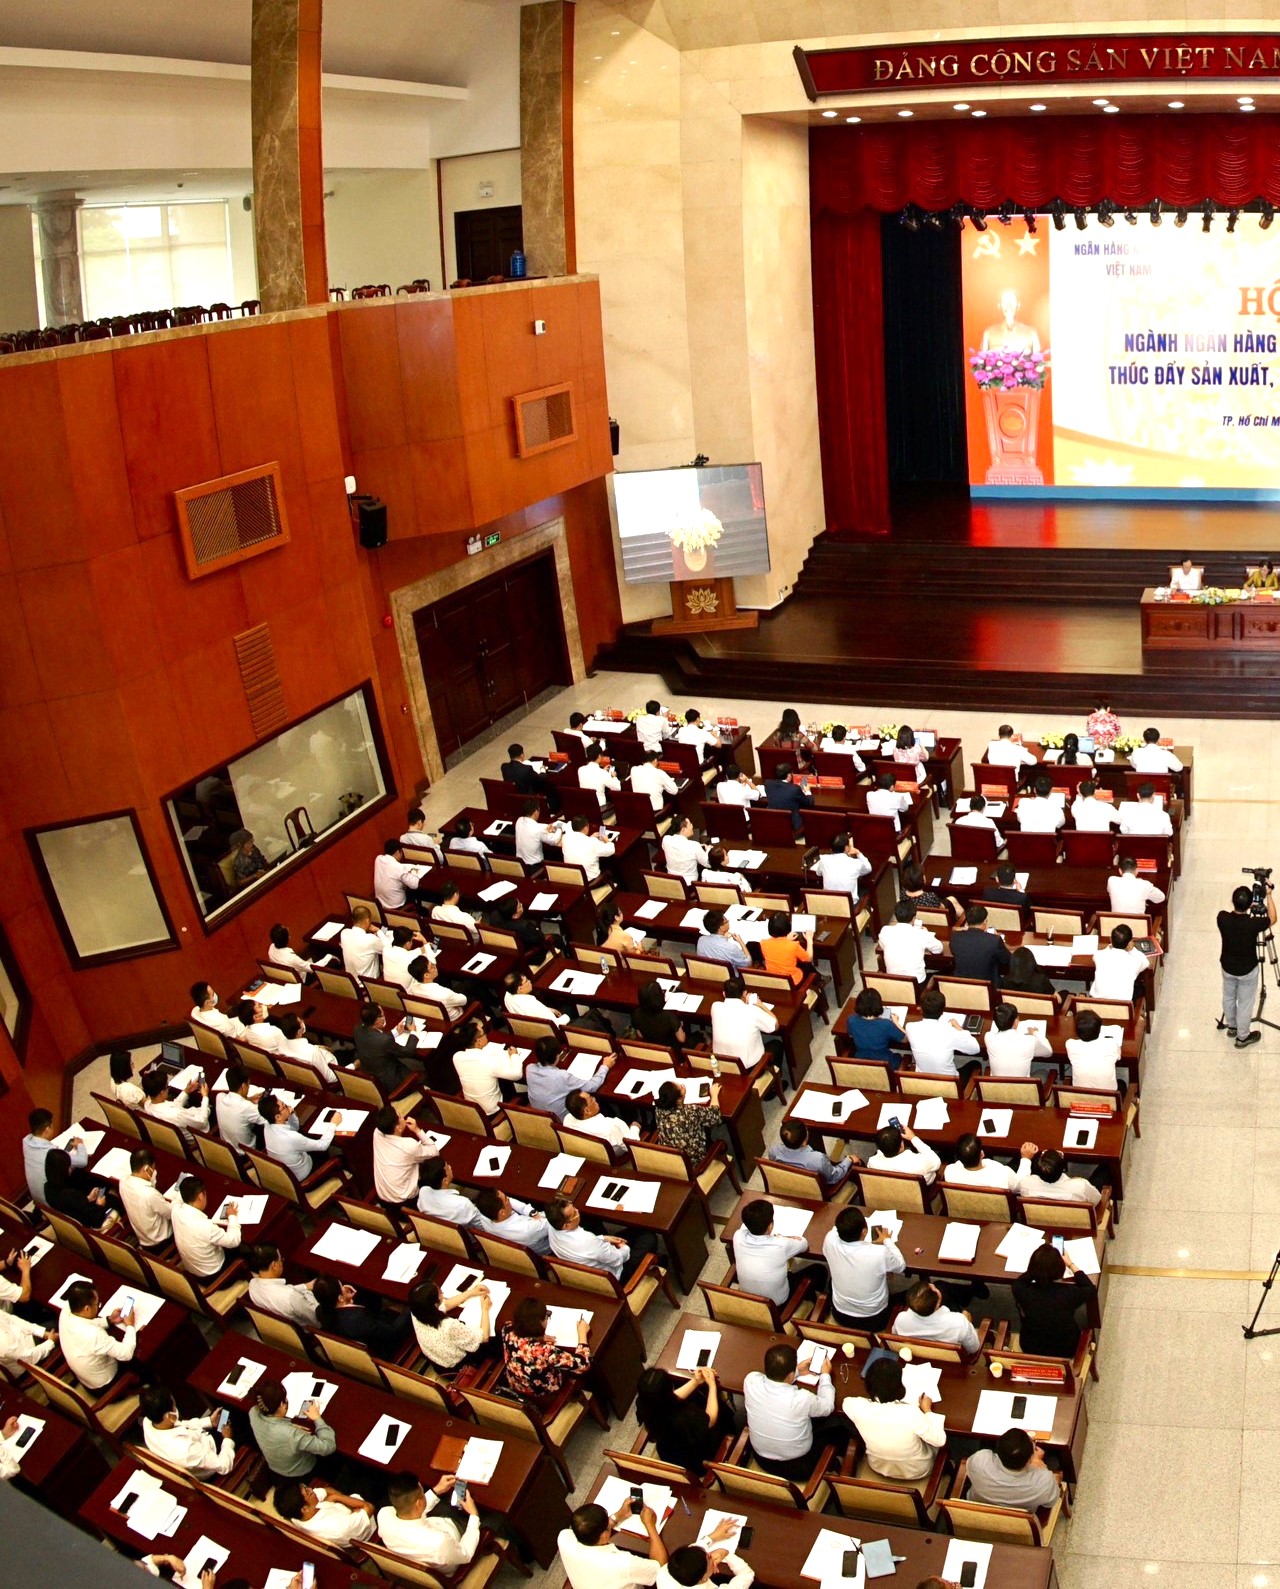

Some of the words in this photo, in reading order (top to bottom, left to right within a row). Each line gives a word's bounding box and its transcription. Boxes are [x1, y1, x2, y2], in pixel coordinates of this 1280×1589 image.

[873, 51, 960, 81] ĐẢNG
[970, 48, 1057, 79] CỘNG
[1066, 43, 1129, 71] SẢN
[1140, 43, 1215, 74] VIỆT
[1074, 240, 1100, 256] NGÂN
[1105, 260, 1126, 278] VIỆT
[1129, 264, 1152, 276] NAM
[1124, 329, 1178, 353] NGÀNH
[1233, 329, 1277, 354] HÀNG
[1108, 361, 1149, 385] THÚC
[1154, 360, 1186, 386] ĐẨY
[1191, 360, 1223, 386] SẢN
[1228, 361, 1274, 388] XUẤT,
[1222, 415, 1234, 427] TP.
